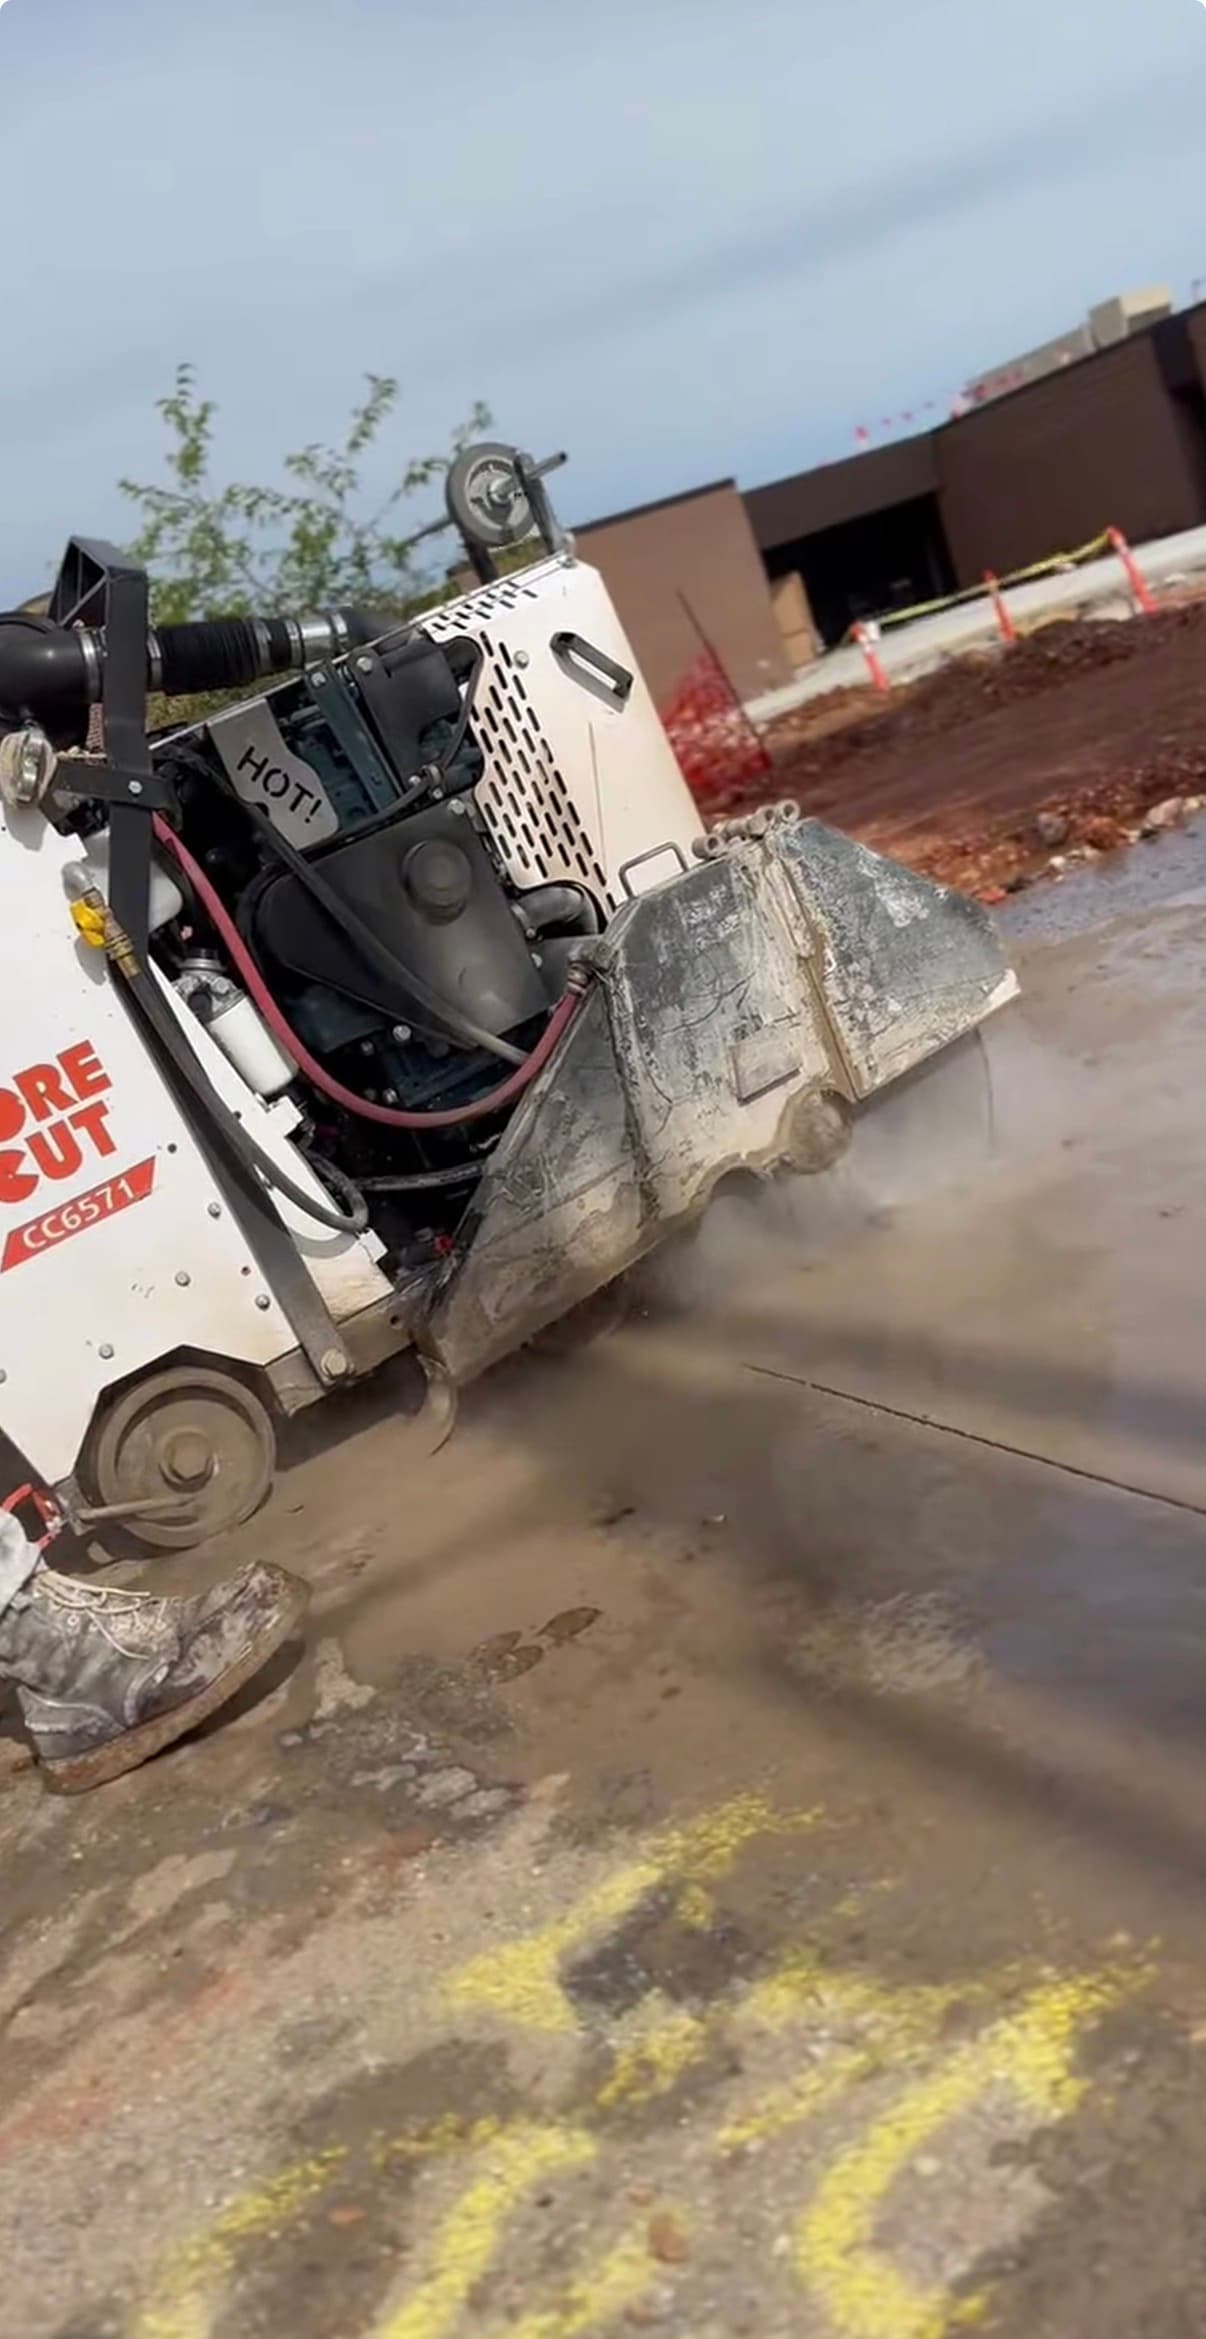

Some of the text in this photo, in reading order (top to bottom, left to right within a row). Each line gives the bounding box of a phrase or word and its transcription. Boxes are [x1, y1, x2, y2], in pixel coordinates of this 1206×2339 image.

[238, 747, 322, 823] HOT!
[0, 1101, 117, 1203] CUT
[22, 1178, 135, 1249] CC6571
